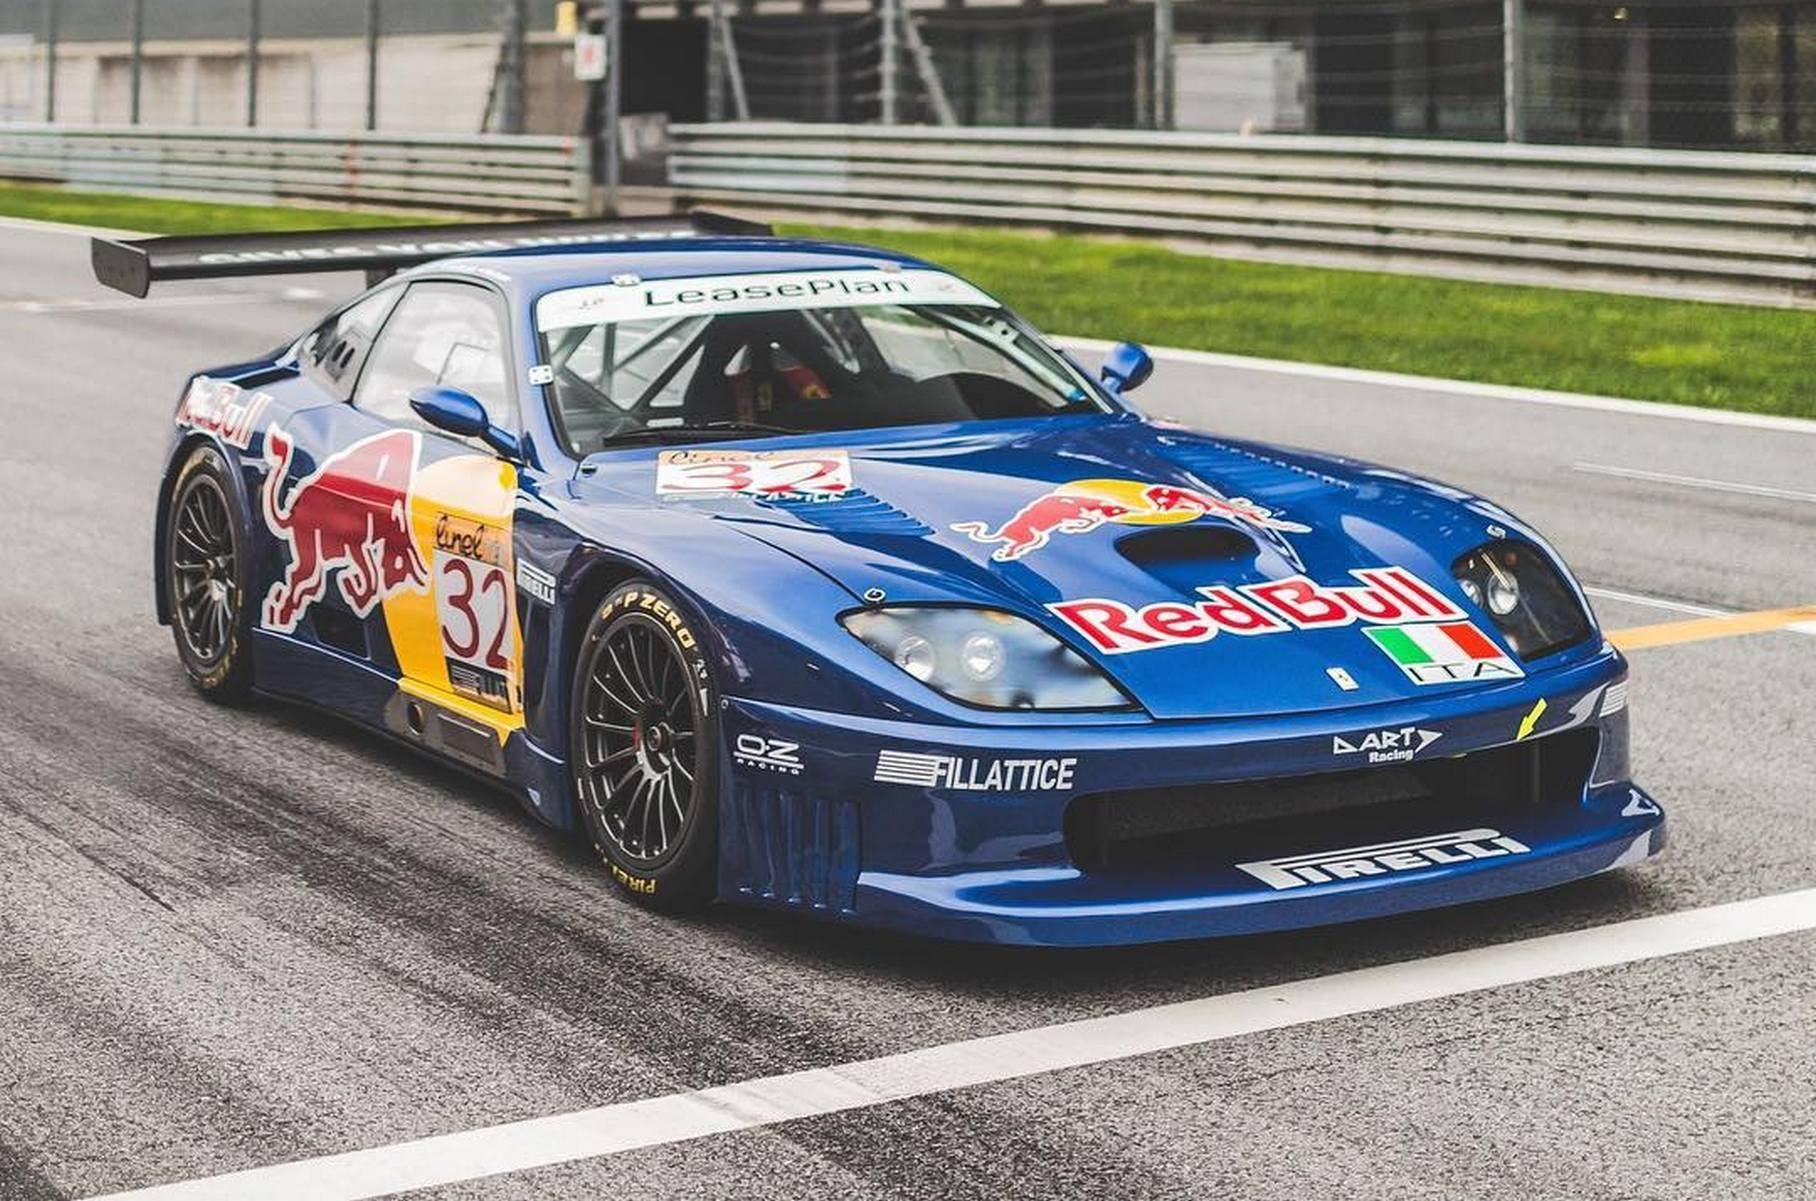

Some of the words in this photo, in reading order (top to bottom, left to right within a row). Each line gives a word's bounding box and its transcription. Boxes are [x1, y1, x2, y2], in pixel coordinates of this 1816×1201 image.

[643, 278, 910, 307] LeasePlan
[661, 459, 848, 493] 32
[441, 558, 513, 670] 32
[1405, 664, 1521, 682] ITA
[737, 758, 800, 775] RACING
[1369, 749, 1414, 764] Racing
[932, 756, 1077, 791] FILLATTICE
[1234, 827, 1532, 891] PIRELLI
